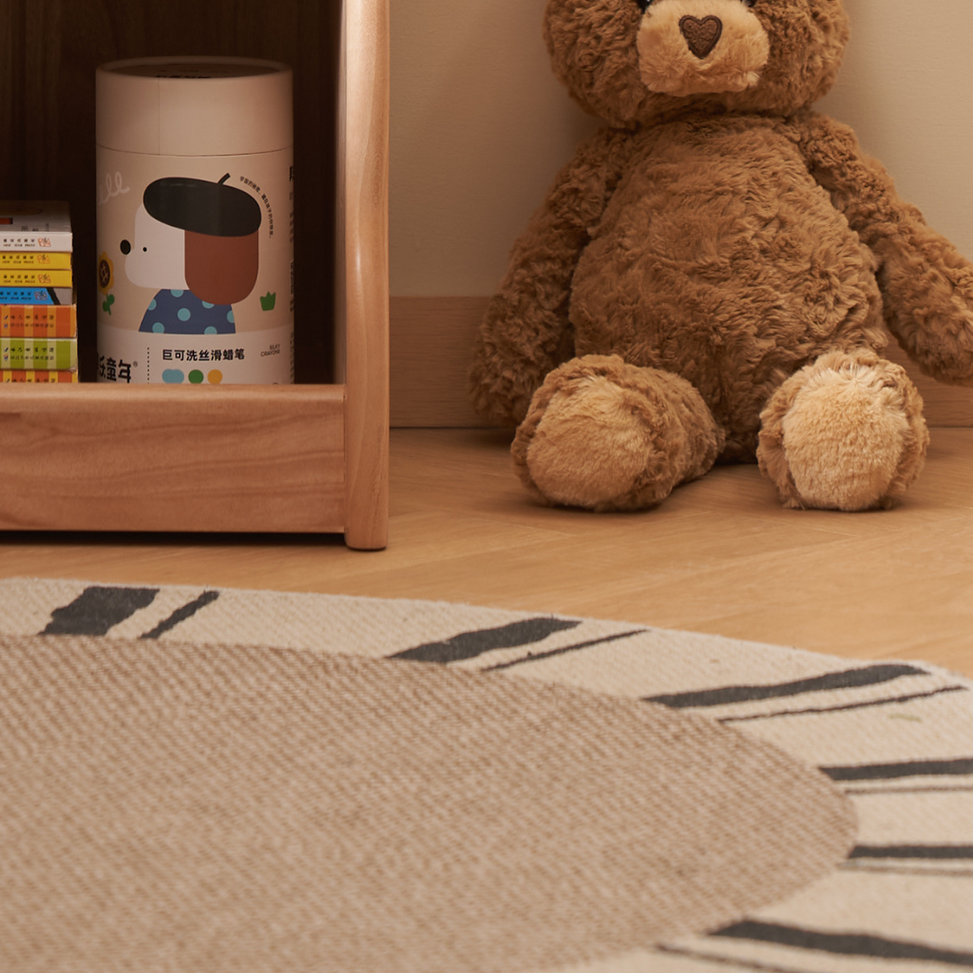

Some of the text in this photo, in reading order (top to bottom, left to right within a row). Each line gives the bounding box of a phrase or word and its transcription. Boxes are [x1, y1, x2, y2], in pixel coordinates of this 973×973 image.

[162, 348, 245, 361] 巨可洗丝滑蜡笔
